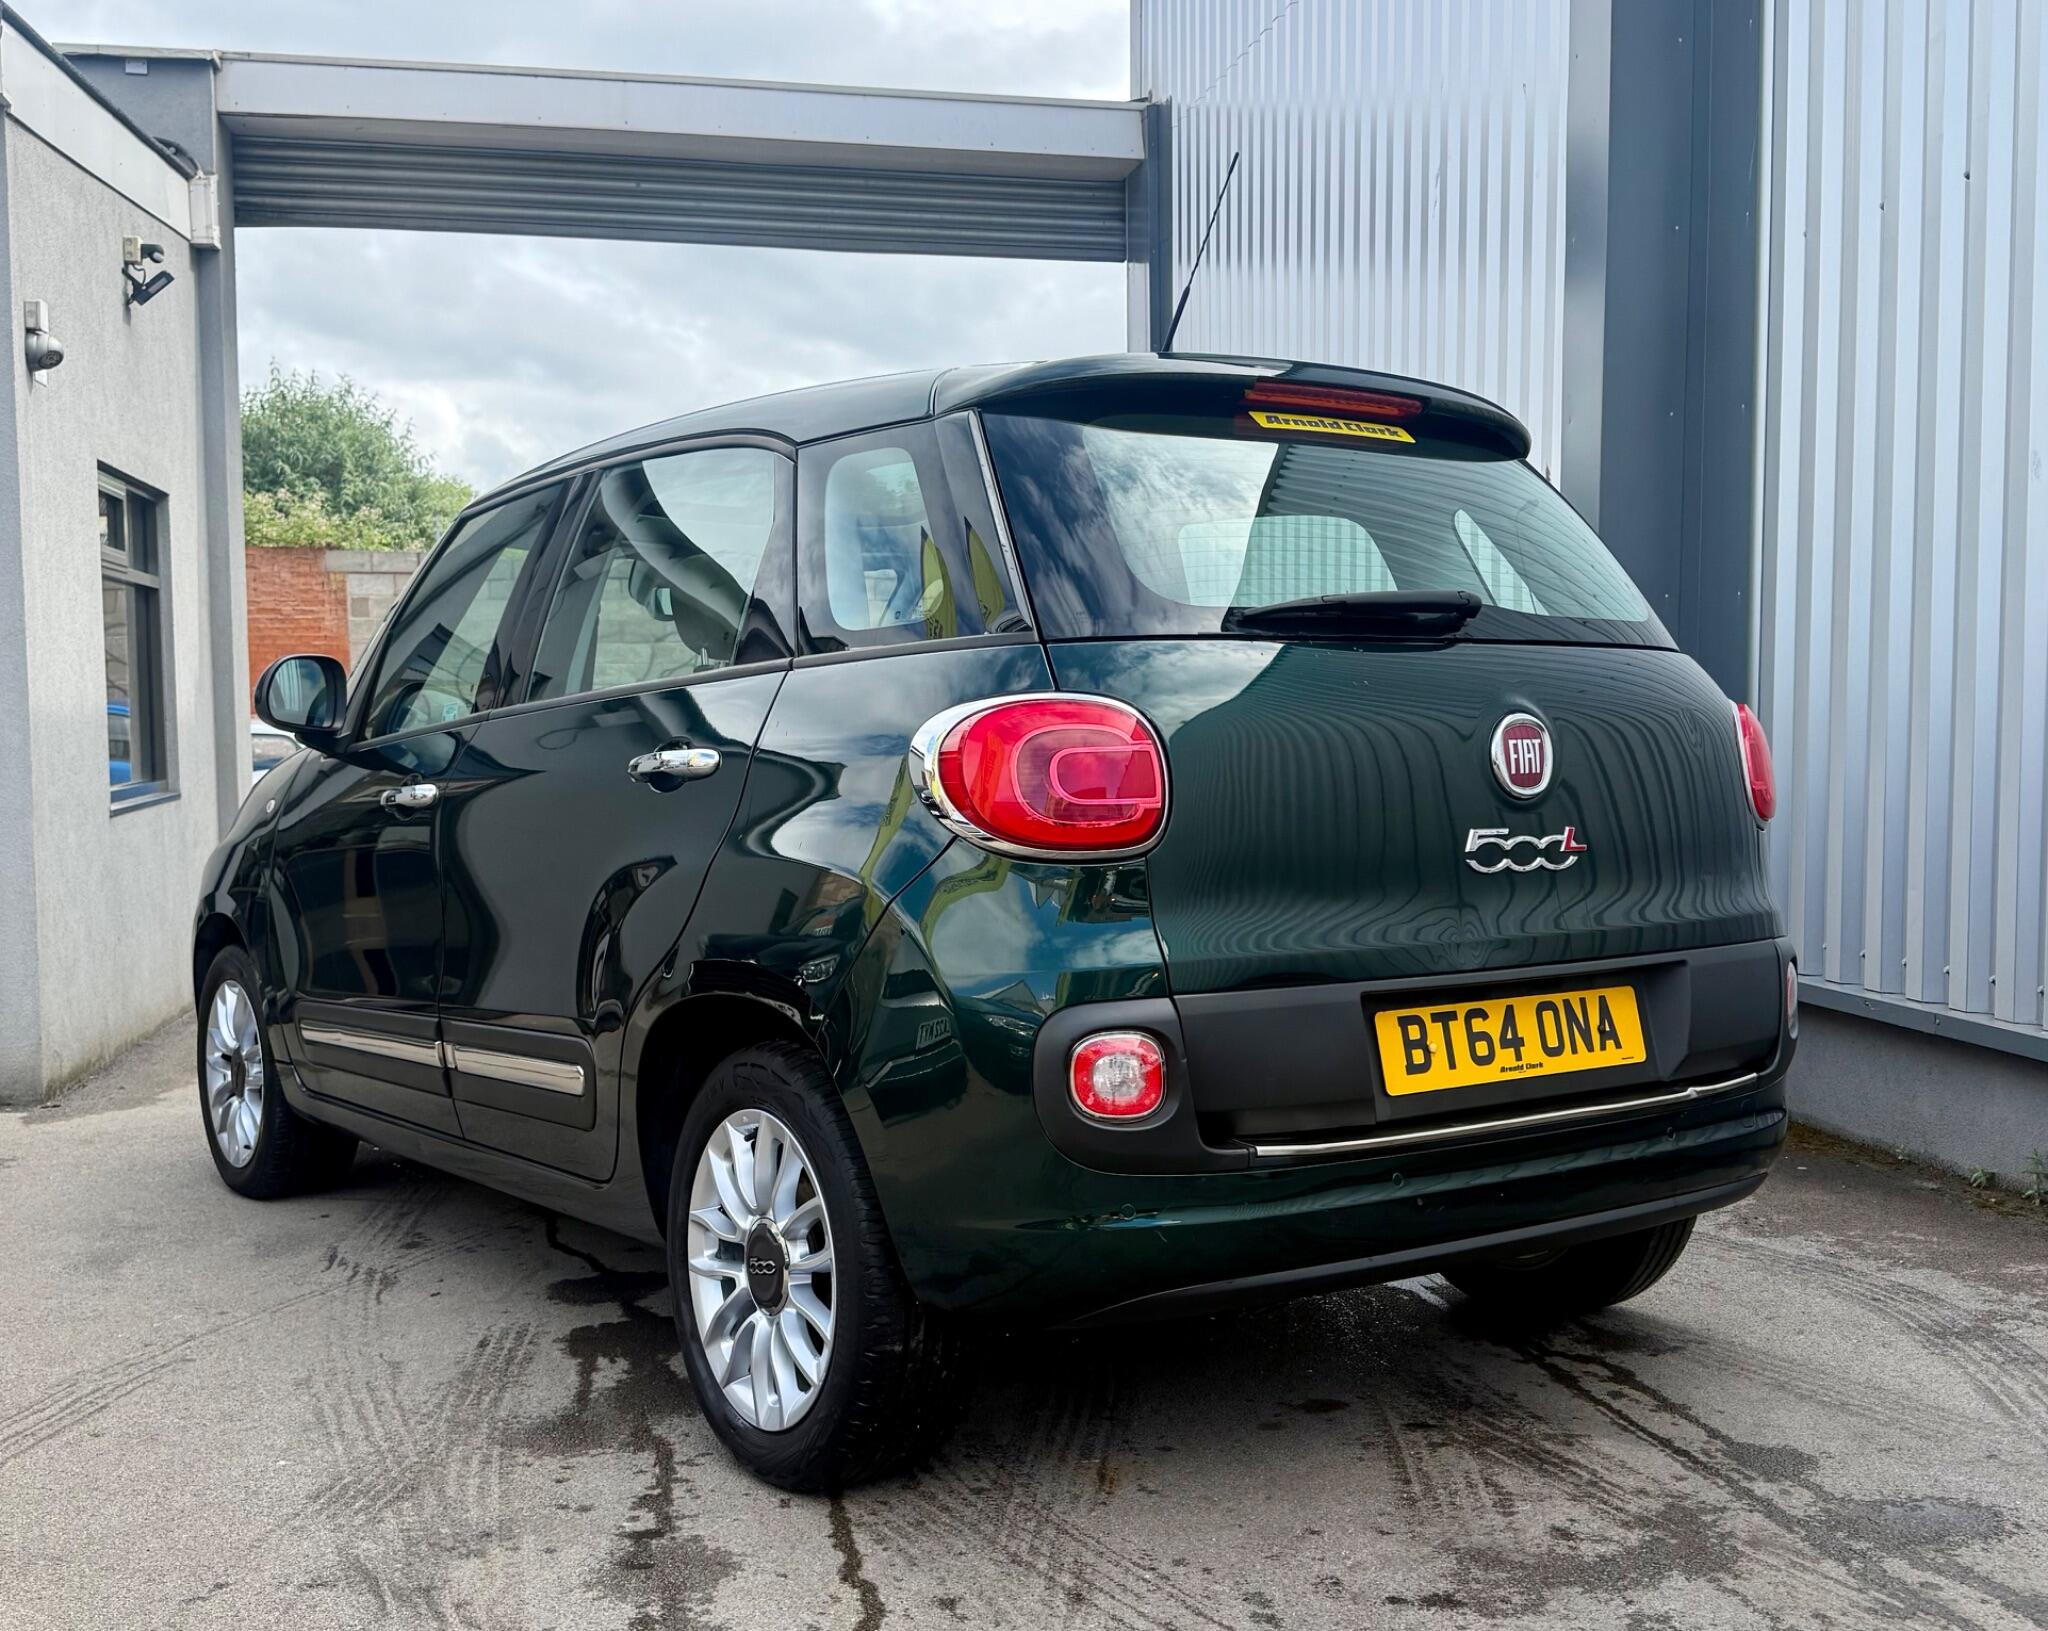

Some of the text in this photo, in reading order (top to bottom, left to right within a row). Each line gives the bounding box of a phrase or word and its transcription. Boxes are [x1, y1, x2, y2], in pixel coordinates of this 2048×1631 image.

[1265, 415, 1403, 438] Arnold Clark
[1508, 739, 1541, 775] FIAT
[1396, 994, 1623, 1076] BT64 ONA
[1500, 1064, 1524, 1073] Arnold
[1525, 1061, 1544, 1070] Clark
[750, 1257, 776, 1274] 500
